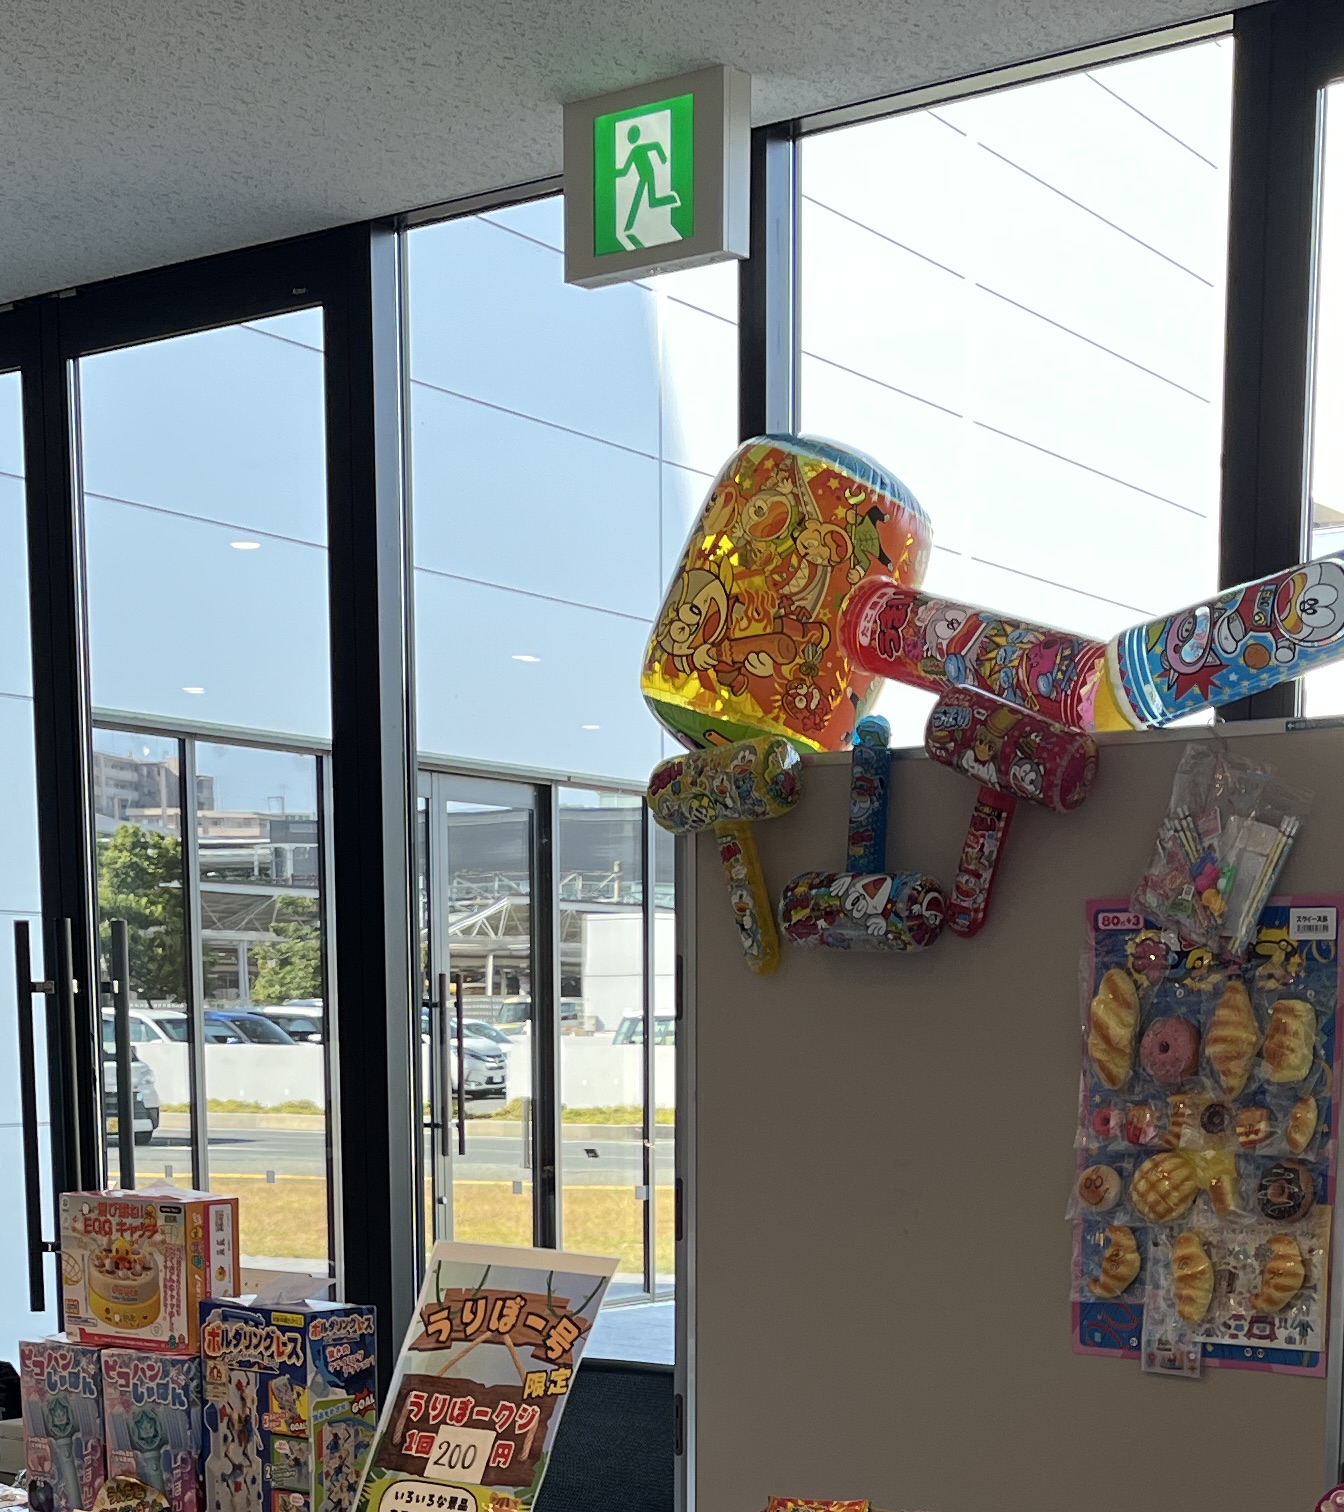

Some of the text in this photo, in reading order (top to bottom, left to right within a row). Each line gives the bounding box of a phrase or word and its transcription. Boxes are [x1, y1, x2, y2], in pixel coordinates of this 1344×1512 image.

[83, 1217, 159, 1239] EGG キャッチ
[424, 1295, 582, 1360] うりぼー号
[21, 1347, 74, 1379] ピコハン
[103, 1357, 163, 1391] ピコハン
[523, 1367, 571, 1399] 限定
[406, 1391, 540, 1434] うりぼークジ
[393, 1490, 469, 1512] いろいろな景品
